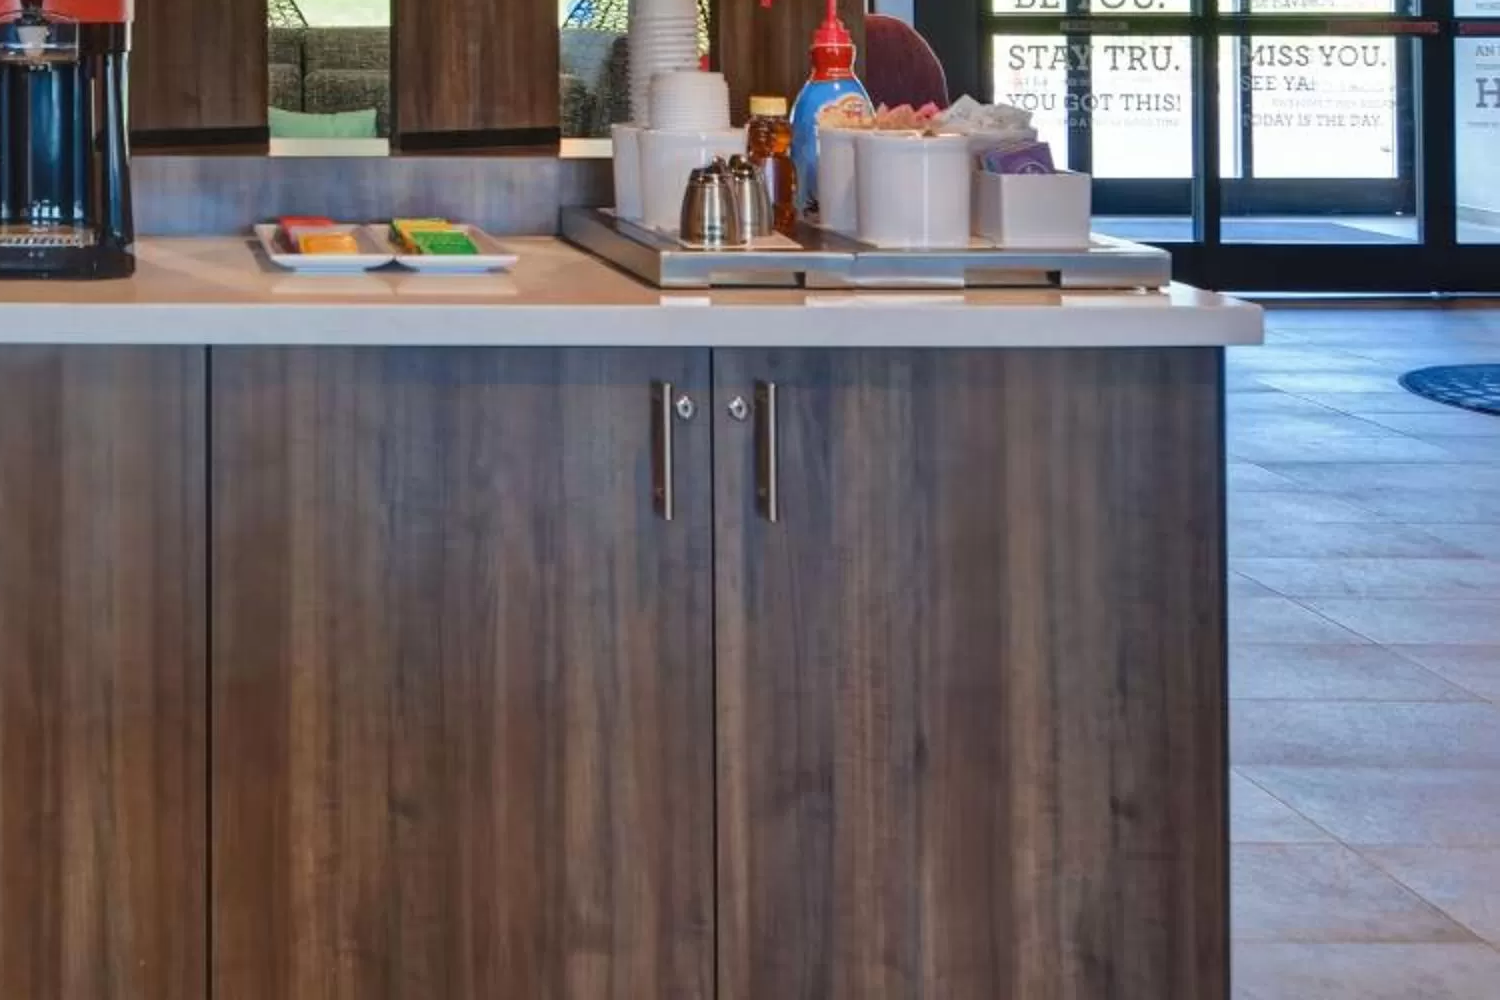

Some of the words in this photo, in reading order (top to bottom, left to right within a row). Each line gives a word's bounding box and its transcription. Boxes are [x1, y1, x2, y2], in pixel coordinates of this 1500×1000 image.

[1008, 45, 1094, 71] STAY
[1103, 45, 1181, 72] TRU.
[1241, 45, 1311, 67] MISS
[1318, 45, 1387, 67] YOU.
[1240, 75, 1278, 91] SEE
[1006, 93, 1057, 111] YOU
[1064, 93, 1114, 112] GOT
[1120, 93, 1182, 112] THIS!
